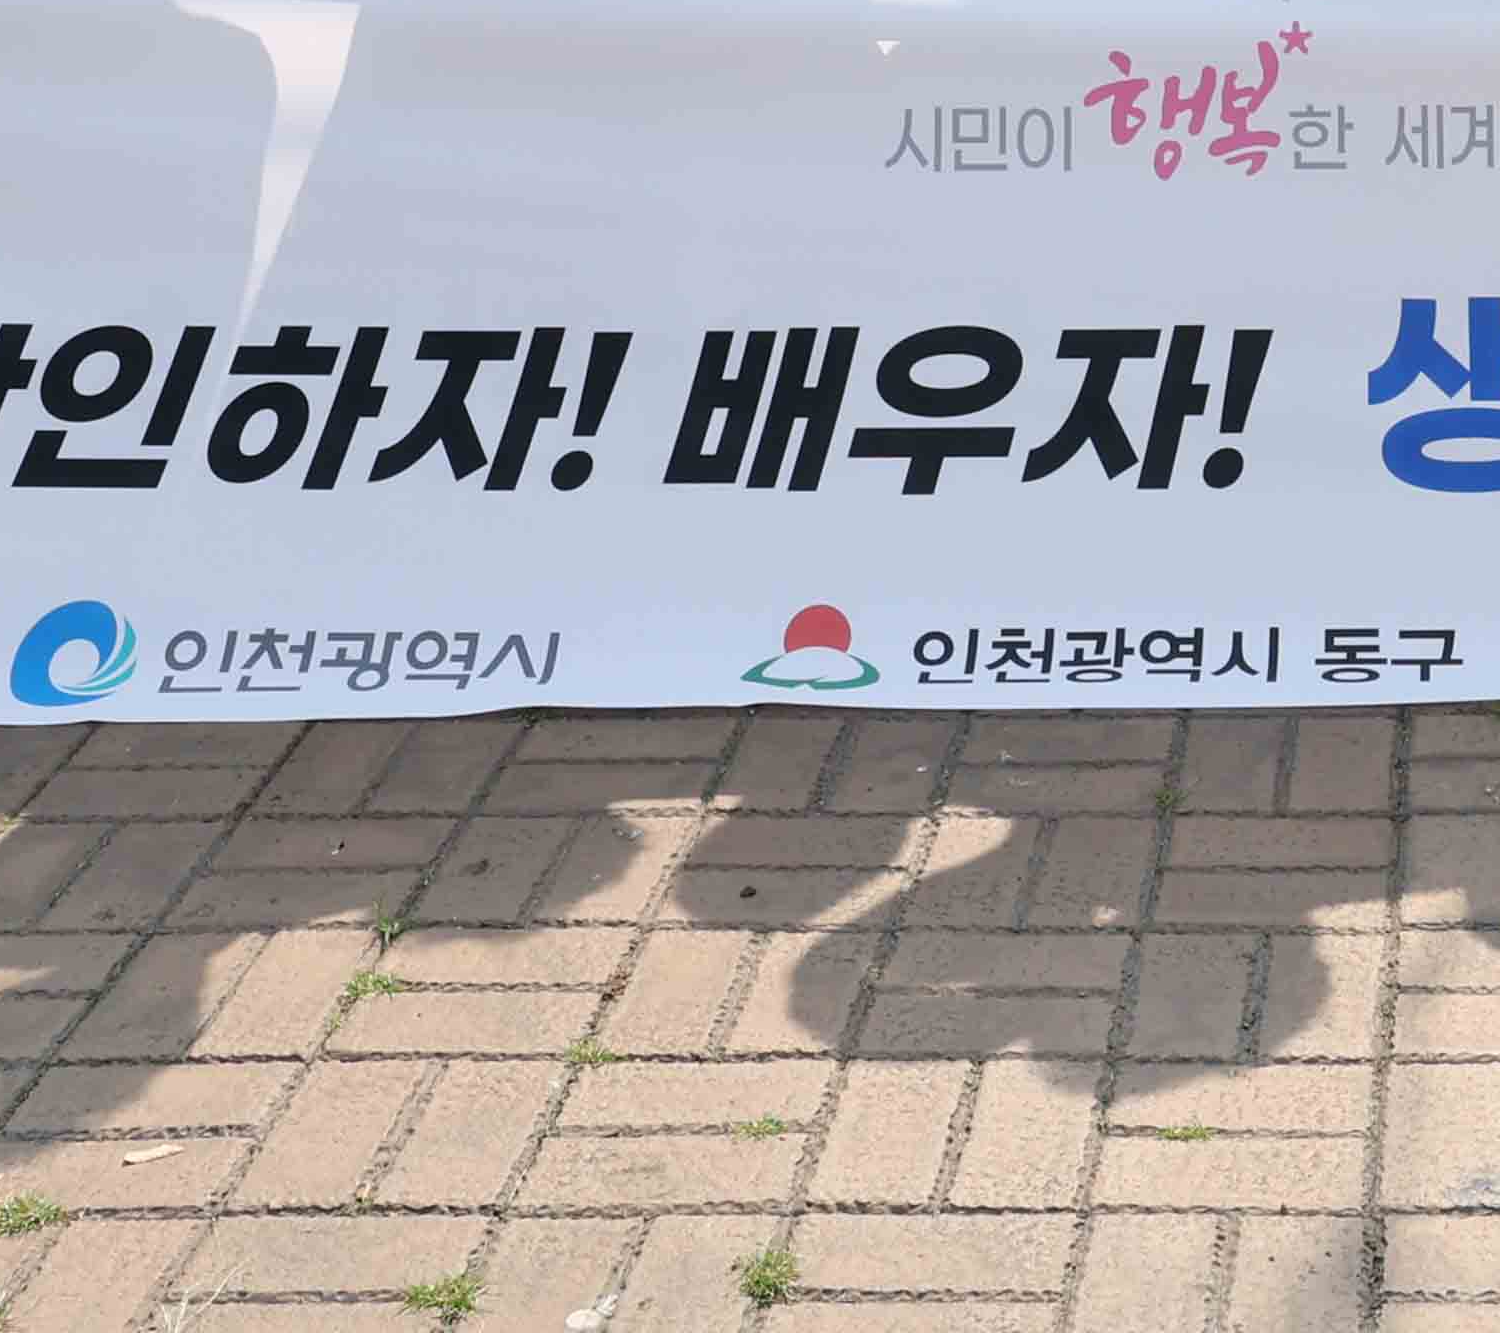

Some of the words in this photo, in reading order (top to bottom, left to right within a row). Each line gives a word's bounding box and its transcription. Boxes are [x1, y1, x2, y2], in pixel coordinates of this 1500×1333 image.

[884, 104, 1075, 173] 시민이
[1083, 49, 1354, 181] 행복한
[661, 324, 1274, 496] 배우자!
[156, 626, 562, 695] 인천광역시
[911, 625, 1282, 687] 인천광역시
[1314, 625, 1465, 683] 동구
